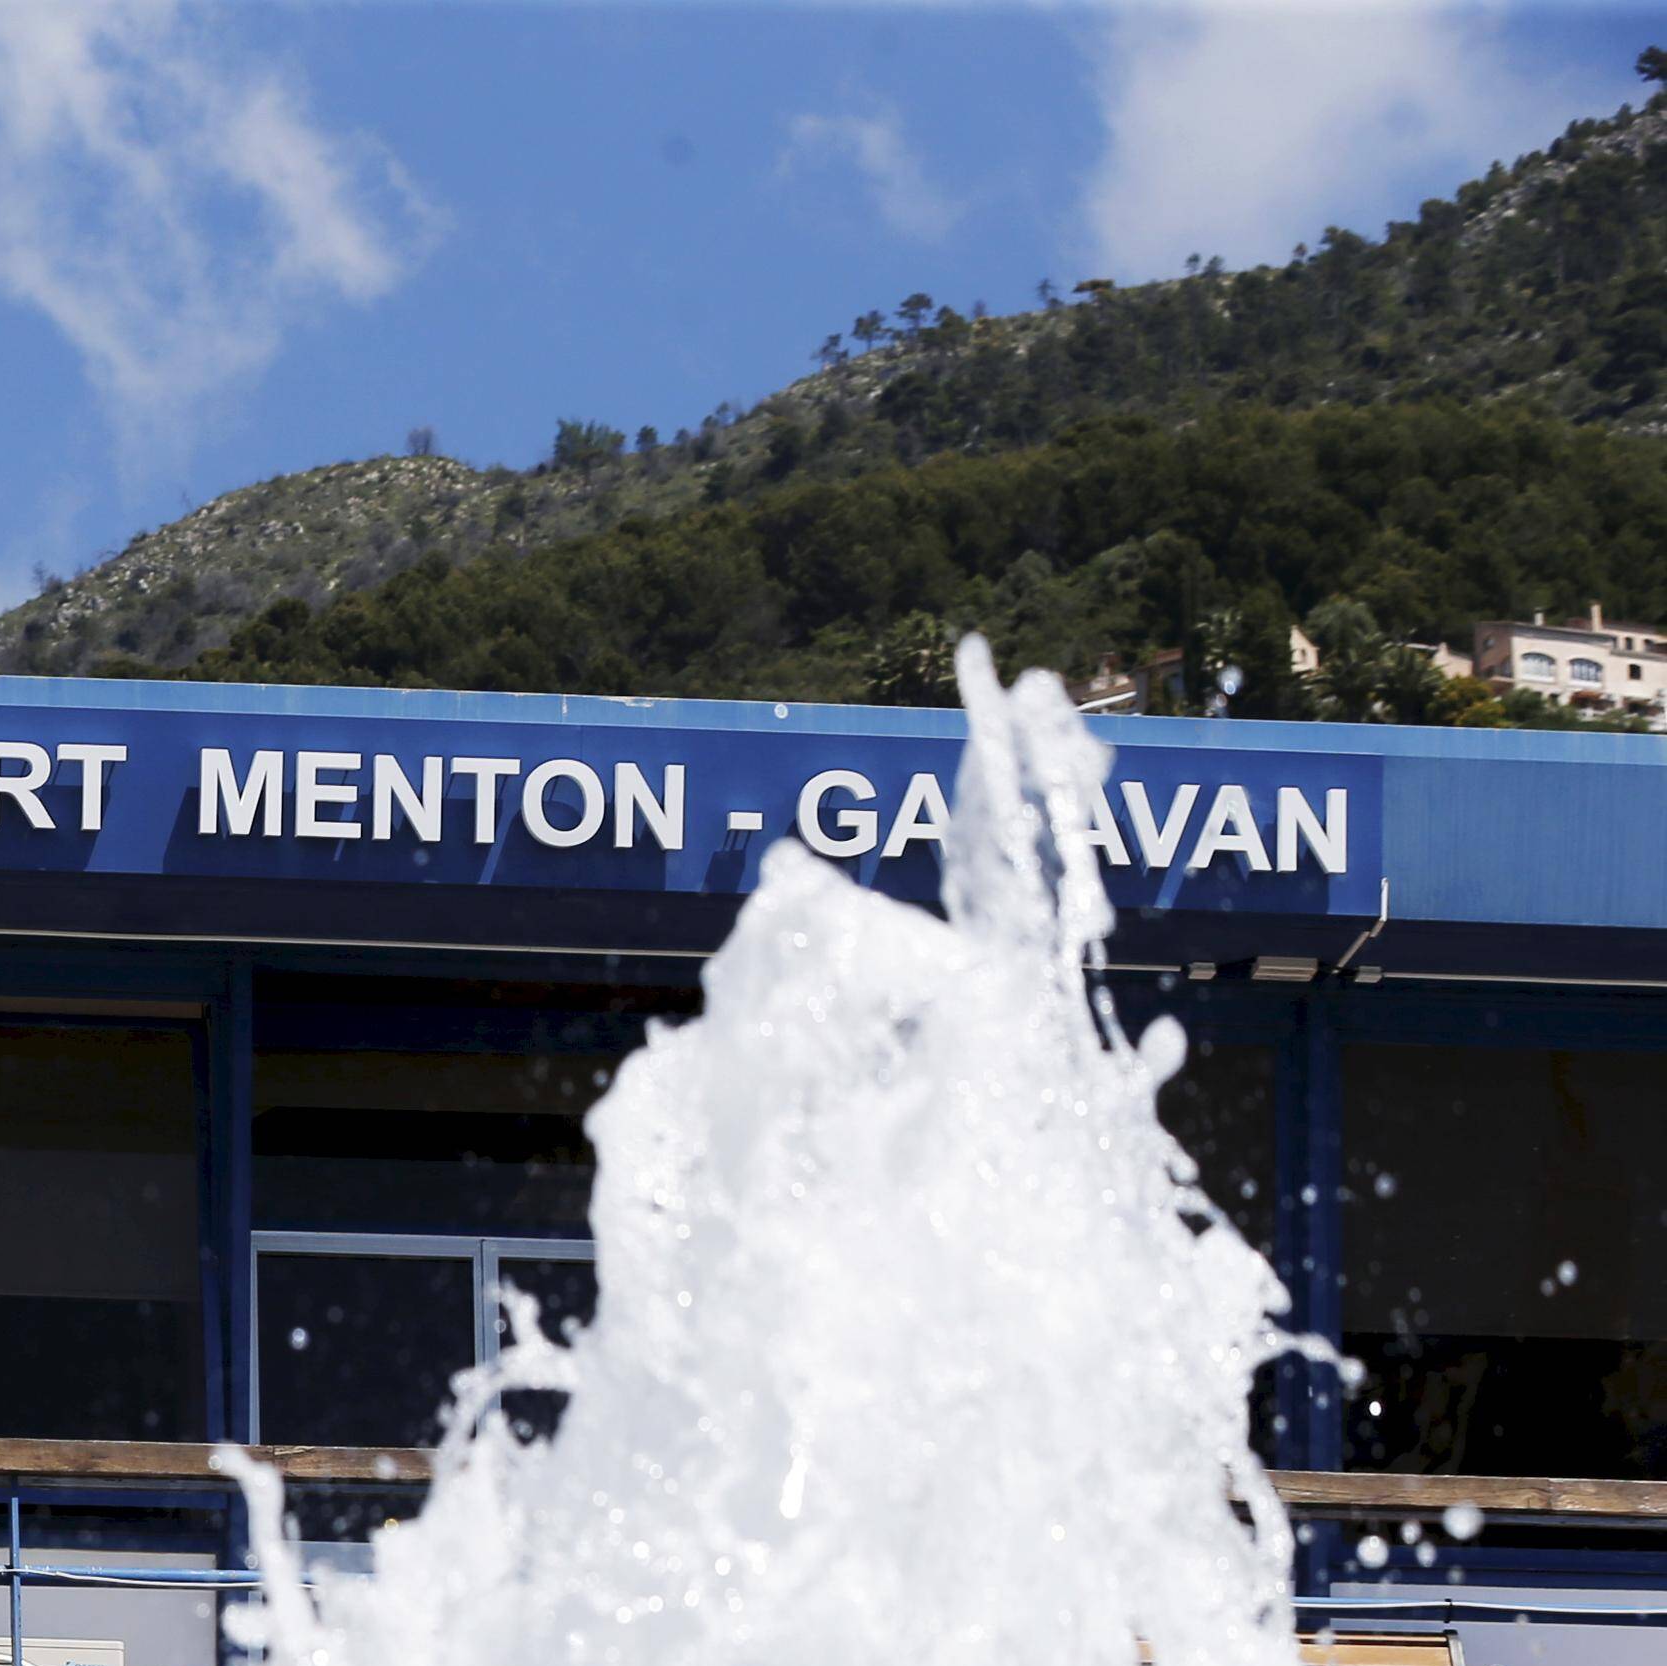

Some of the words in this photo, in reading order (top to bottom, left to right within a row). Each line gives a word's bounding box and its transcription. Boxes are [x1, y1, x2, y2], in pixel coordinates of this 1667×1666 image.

[198, 747, 685, 851] MENTON
[726, 811, 763, 831] -
[796, 769, 1348, 874] GAAVAN
